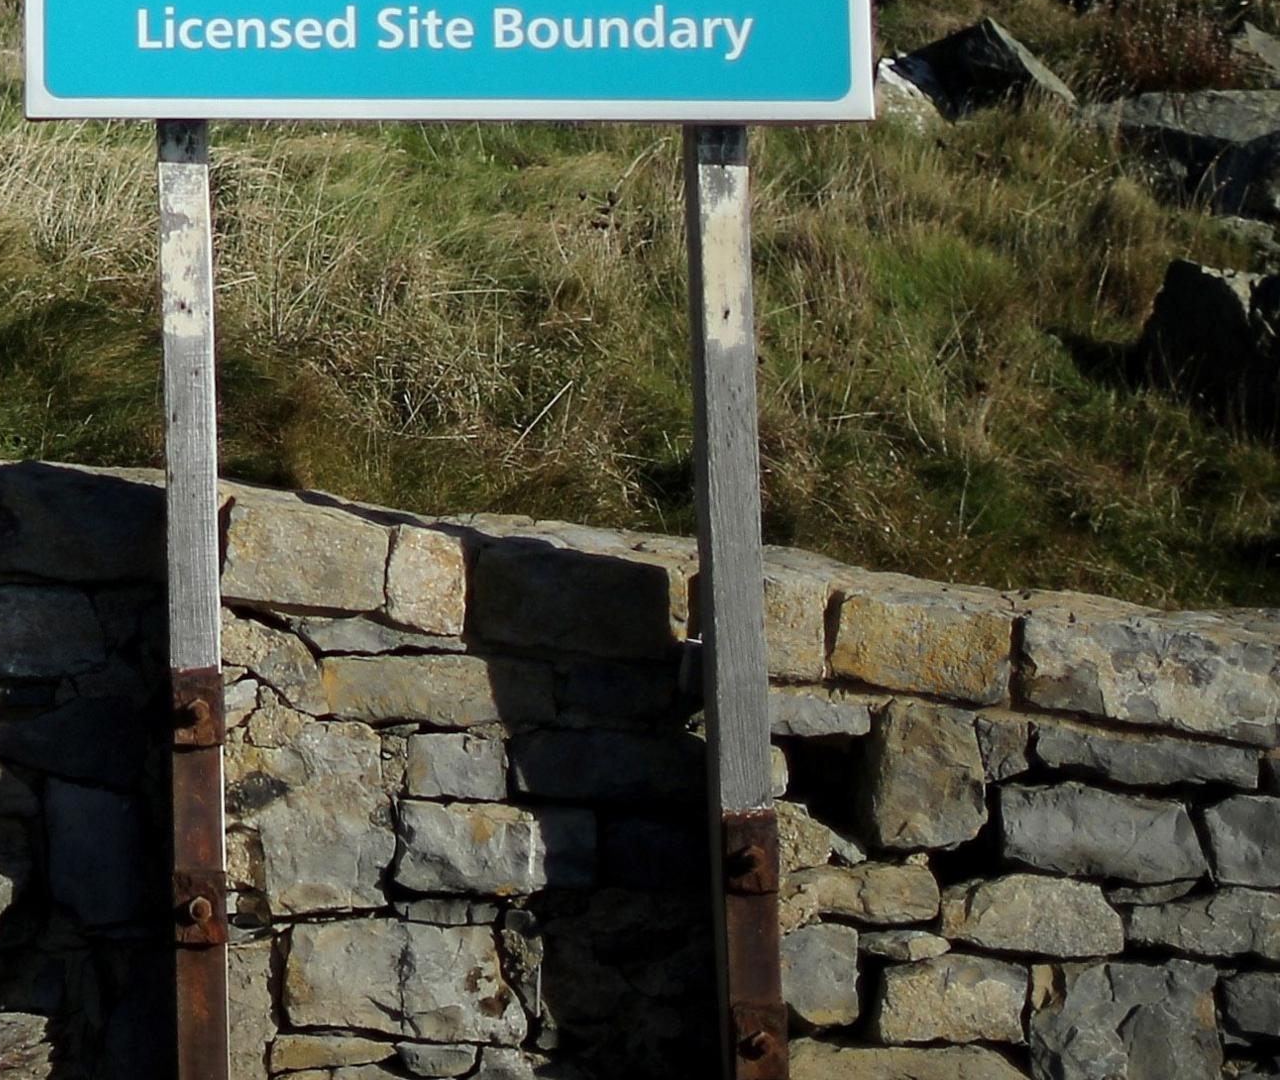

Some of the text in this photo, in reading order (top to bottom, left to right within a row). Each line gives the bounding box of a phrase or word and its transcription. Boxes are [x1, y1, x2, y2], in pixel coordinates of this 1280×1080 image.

[137, 4, 754, 61] Licensed Site Boundary
